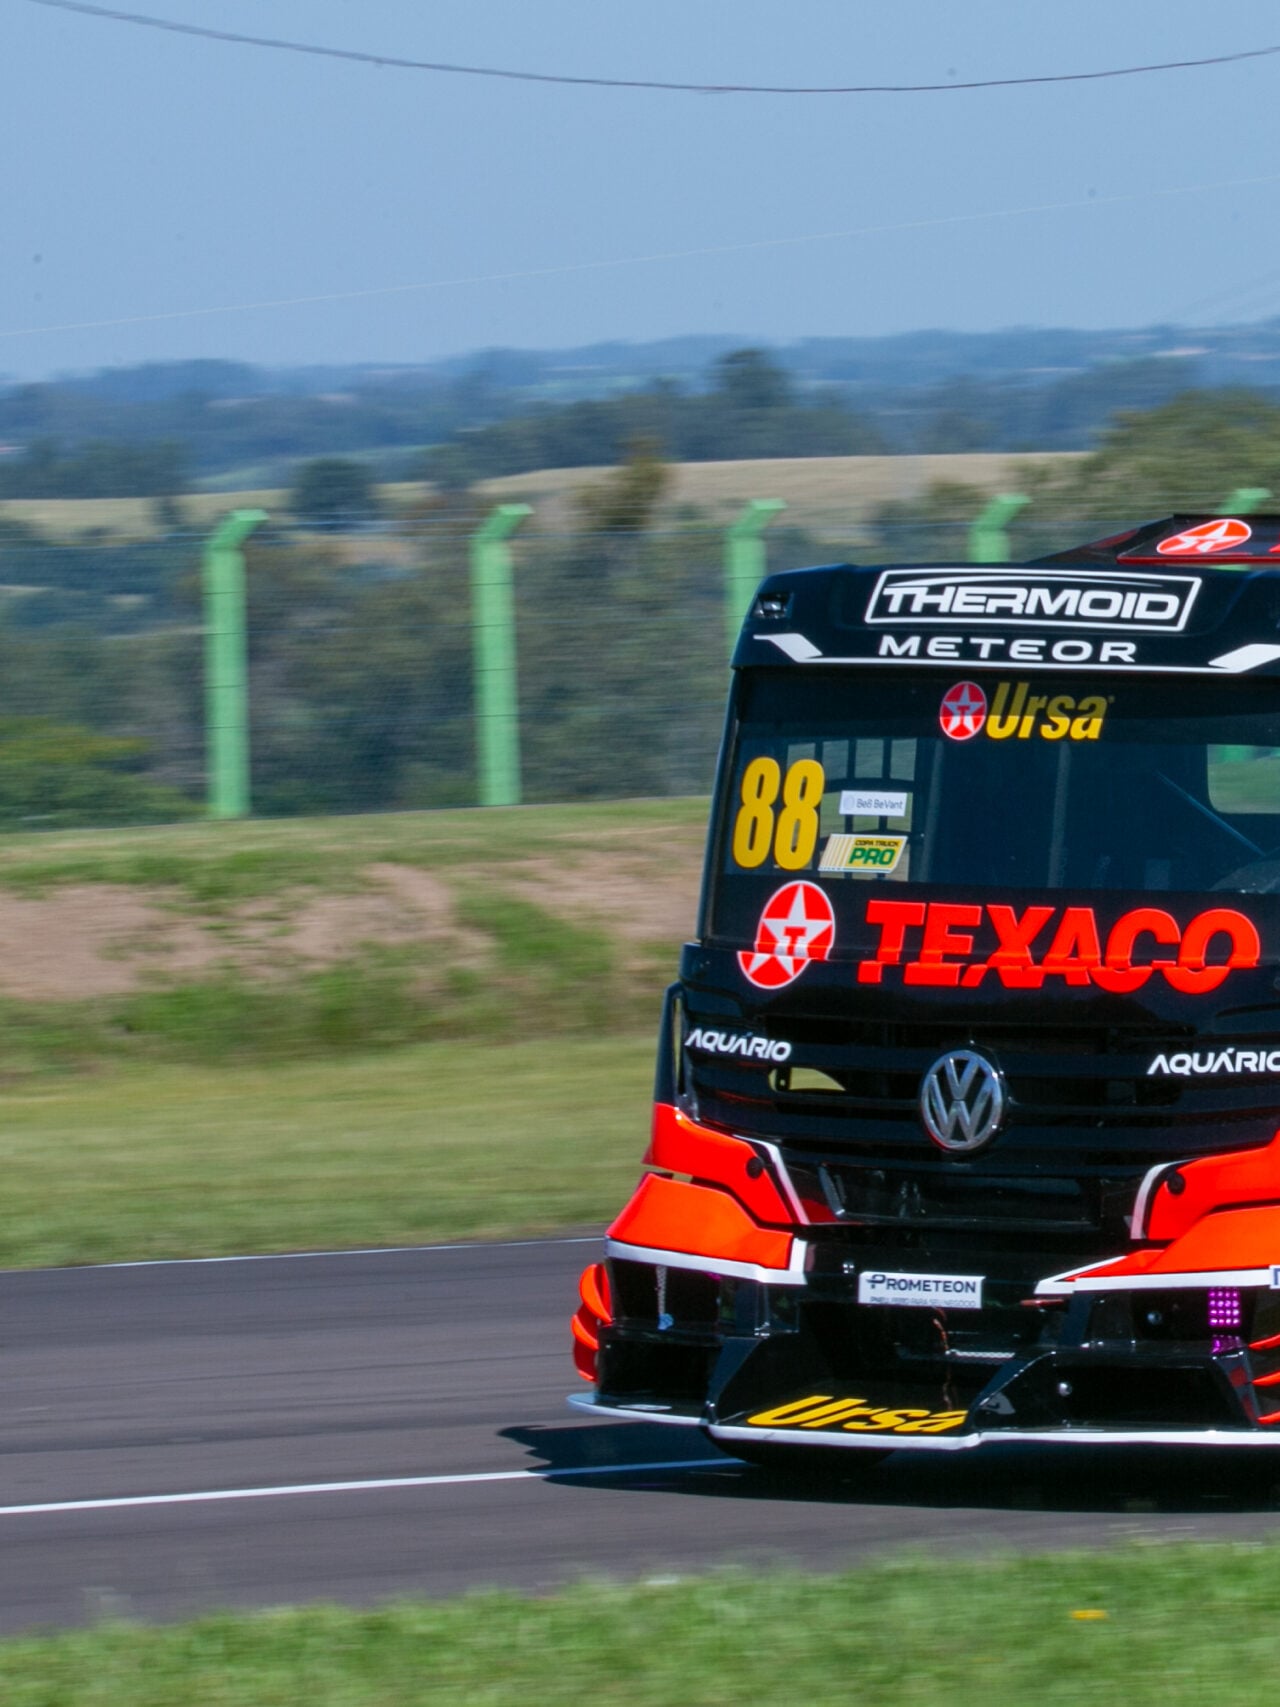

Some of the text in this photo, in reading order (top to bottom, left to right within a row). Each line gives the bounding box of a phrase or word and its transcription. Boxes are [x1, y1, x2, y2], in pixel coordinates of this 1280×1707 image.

[882, 585, 1180, 620] THERMOID
[878, 635, 1137, 662] METEOR
[986, 682, 1108, 739] Ursa
[733, 756, 825, 871] 88
[848, 847, 896, 865] PRO
[858, 900, 1260, 994] TEXACO
[685, 1029, 792, 1062] AQUÁRIO
[866, 1274, 976, 1293] PROMETEON
[746, 1396, 968, 1433] Ursa
